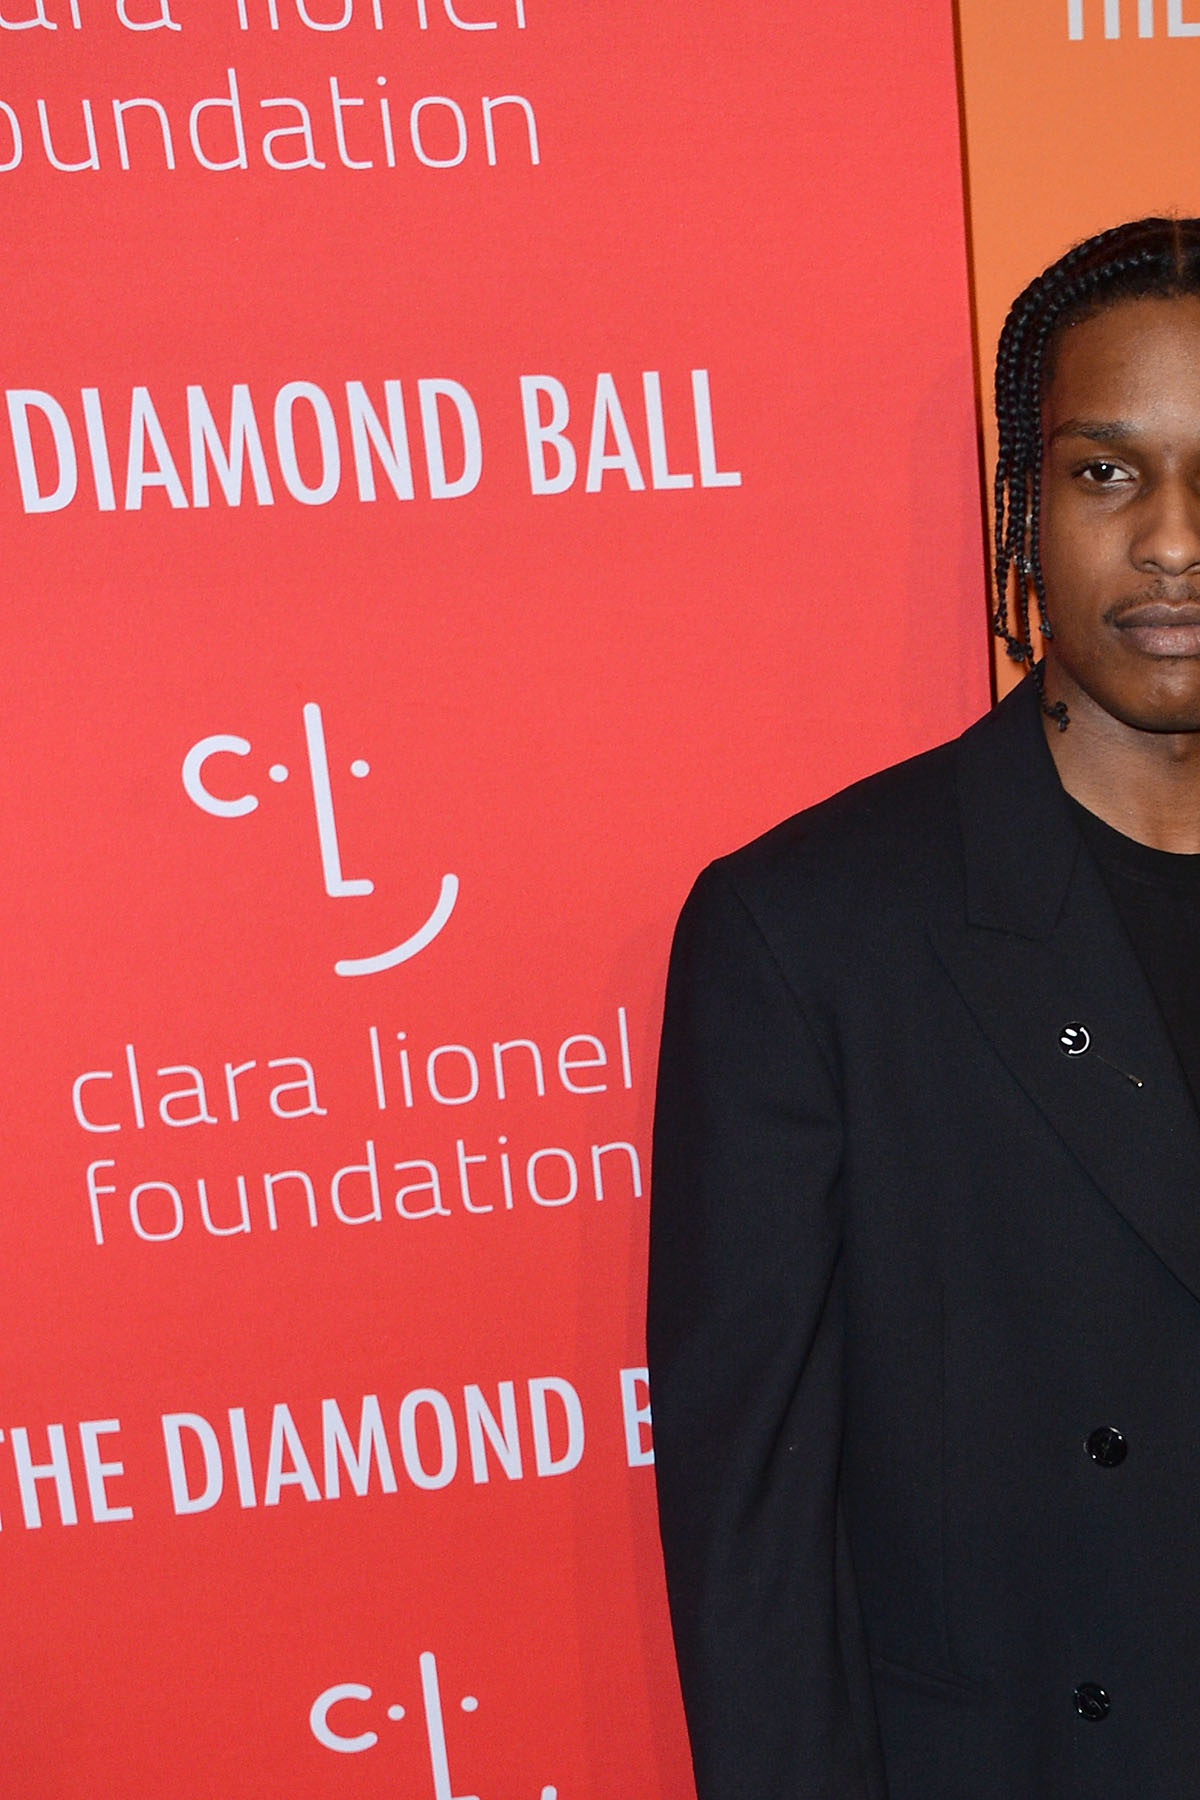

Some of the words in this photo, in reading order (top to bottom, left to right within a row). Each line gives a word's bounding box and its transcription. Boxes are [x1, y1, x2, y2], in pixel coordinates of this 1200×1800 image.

[5, 378, 483, 514] DIAMOND
[519, 369, 742, 495] BALL
[72, 1043, 328, 1134] clara
[369, 1006, 634, 1110] lionel
[86, 1134, 643, 1246] foundation
[0, 1418, 134, 1533] HE
[161, 1376, 585, 1515] DIAMOND
